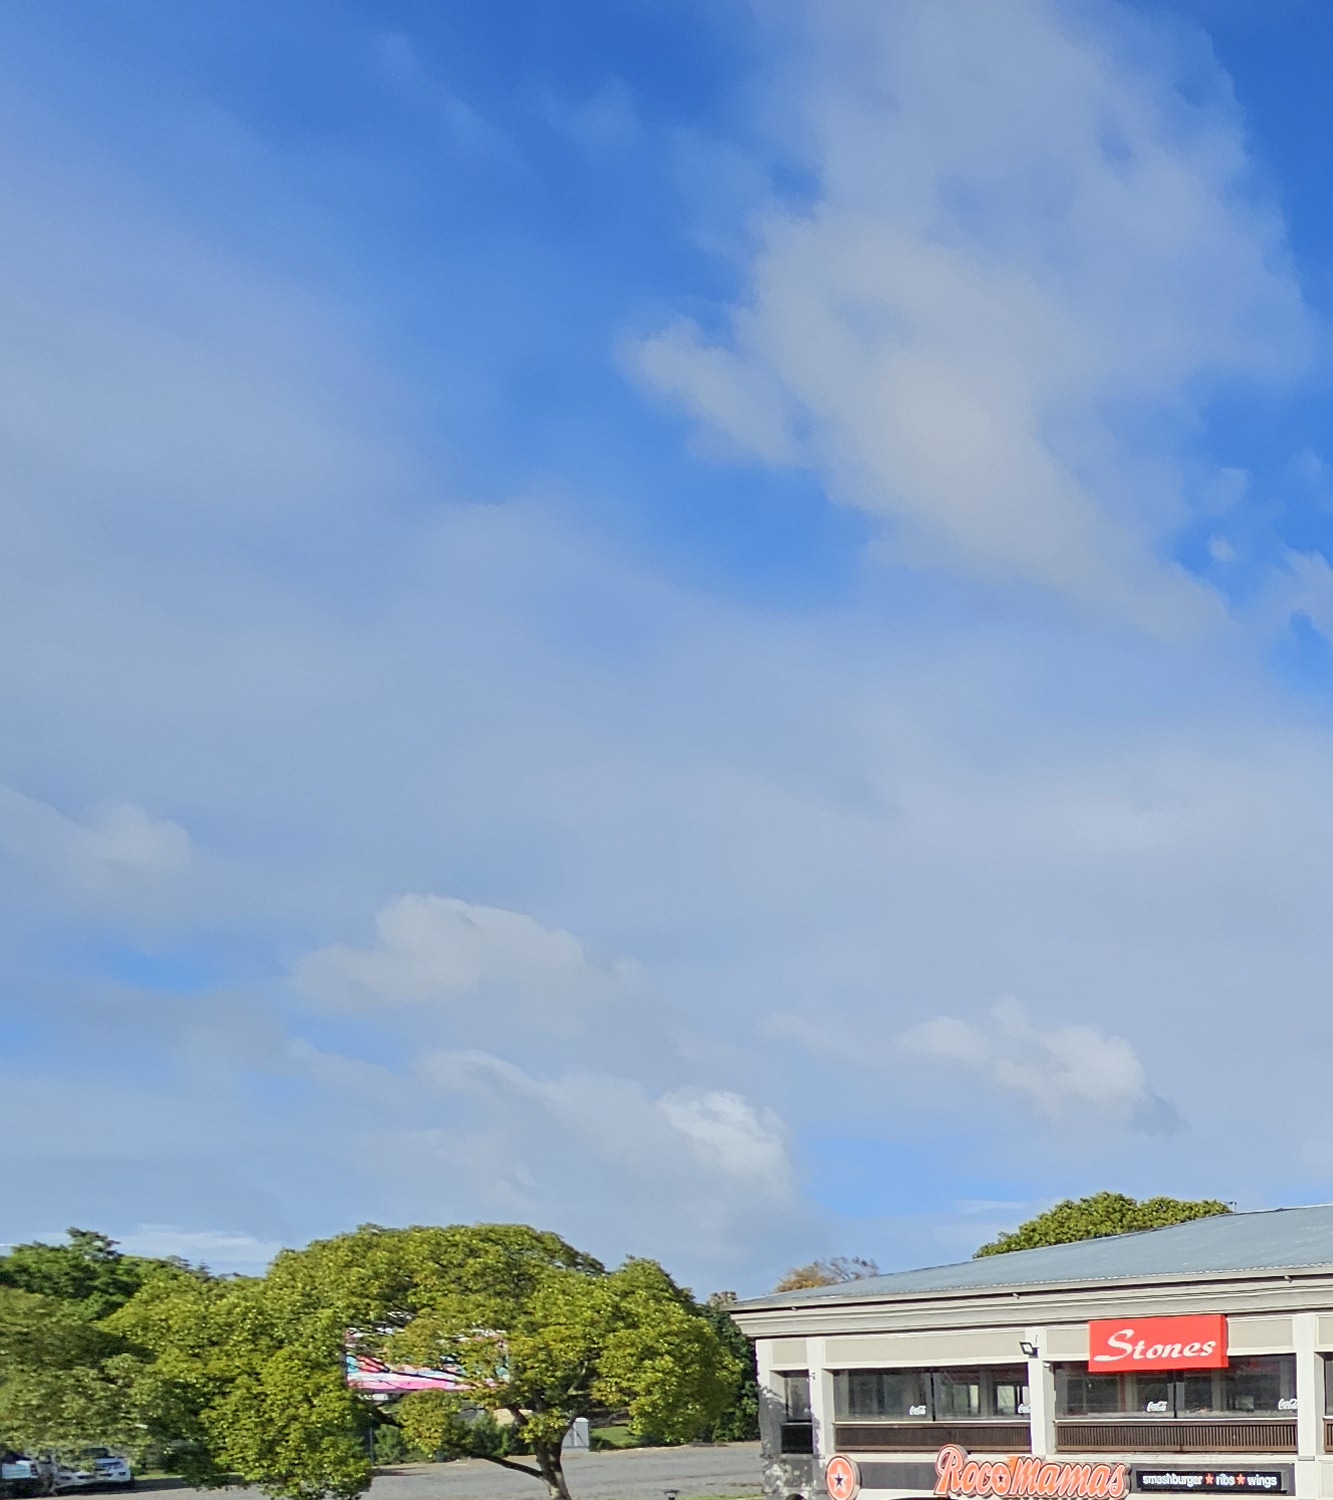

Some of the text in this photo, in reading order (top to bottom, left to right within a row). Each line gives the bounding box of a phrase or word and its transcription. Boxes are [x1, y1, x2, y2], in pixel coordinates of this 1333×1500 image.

[1093, 1329, 1217, 1362] Stones
[1142, 1473, 1277, 1488] smashburger ribs wings
